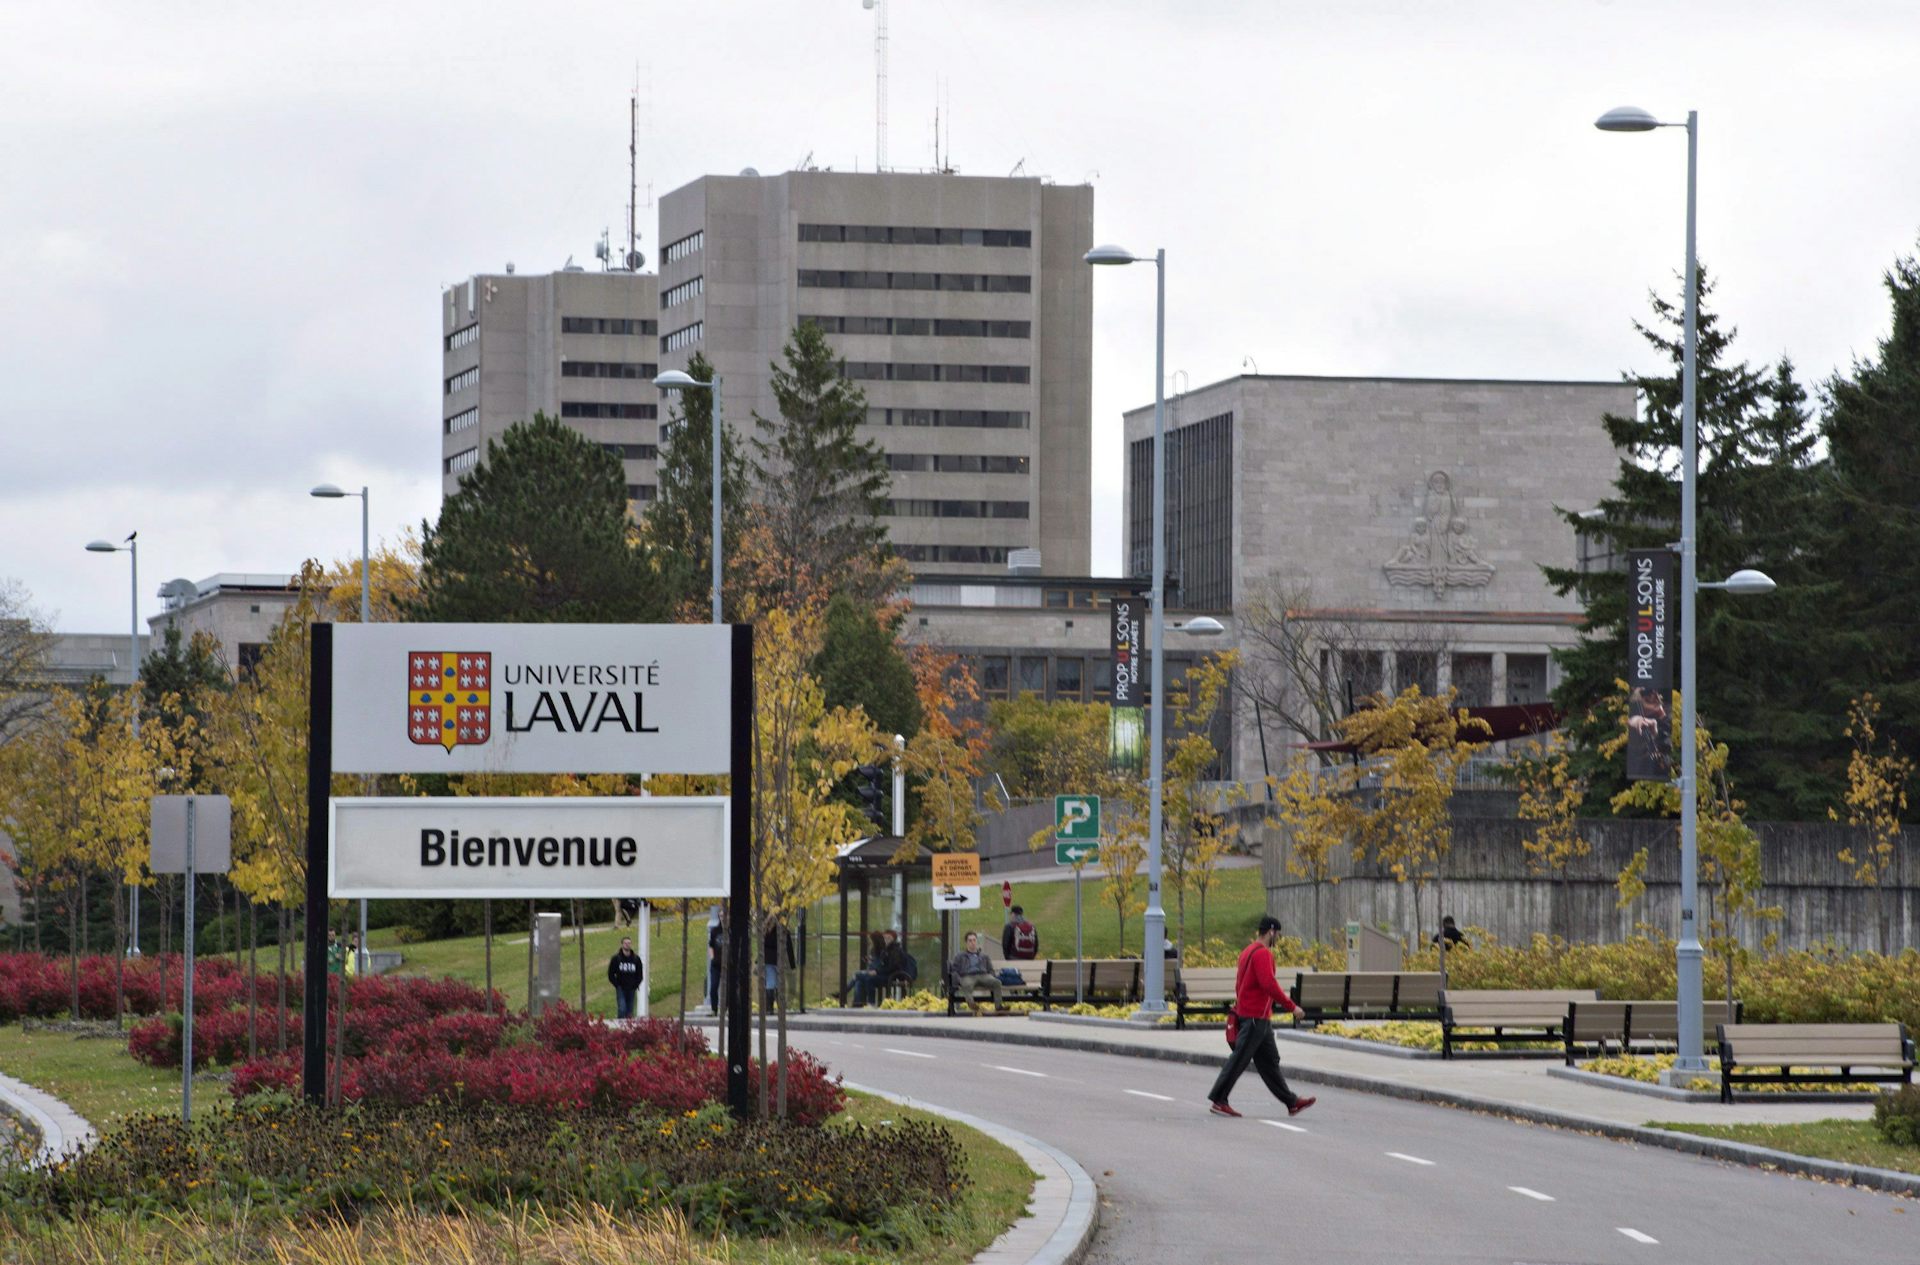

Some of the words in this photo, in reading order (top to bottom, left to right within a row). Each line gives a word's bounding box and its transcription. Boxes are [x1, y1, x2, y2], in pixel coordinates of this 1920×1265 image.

[1637, 558, 1653, 680] PROPULSONS
[1655, 578, 1665, 622] CULTURE
[1116, 603, 1130, 700] PROPULSONS
[1655, 624, 1665, 659] NOTRE
[504, 659, 660, 686] UNIVERSITÉ
[1130, 656, 1139, 684] NOTRE
[503, 691, 659, 733] LAVAL
[1064, 800, 1091, 835] P
[420, 828, 638, 867] Bienvenue
